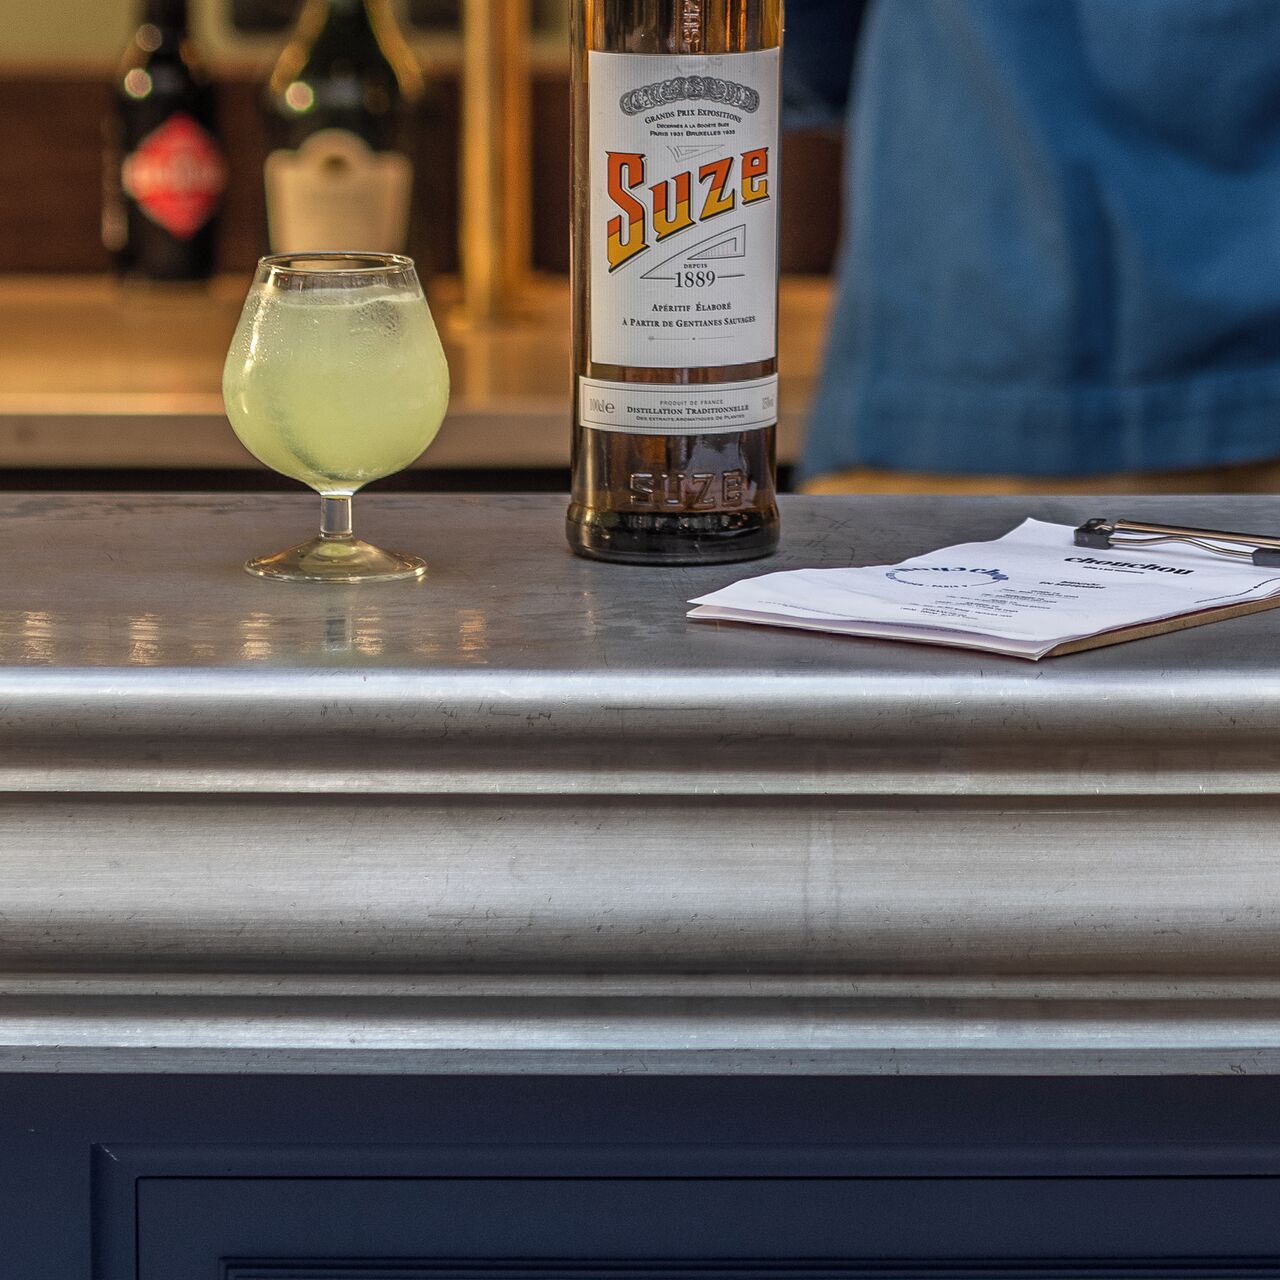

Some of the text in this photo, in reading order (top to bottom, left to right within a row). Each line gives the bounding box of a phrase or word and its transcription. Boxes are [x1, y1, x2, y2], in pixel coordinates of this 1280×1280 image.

[644, 108, 742, 125] GRANDS PRIX EXPOSITIONS
[605, 147, 770, 274] Suze
[675, 271, 716, 288] 1889
[651, 301, 732, 312] APÉRITIF ÉLABORÉ
[630, 319, 660, 327] PARTIR
[675, 319, 722, 328] GENTIANES
[723, 316, 756, 325] SAUVAGES
[626, 404, 749, 415] DISTILLATION TRADITIONNELLE
[1064, 555, 1195, 576] chouchou
